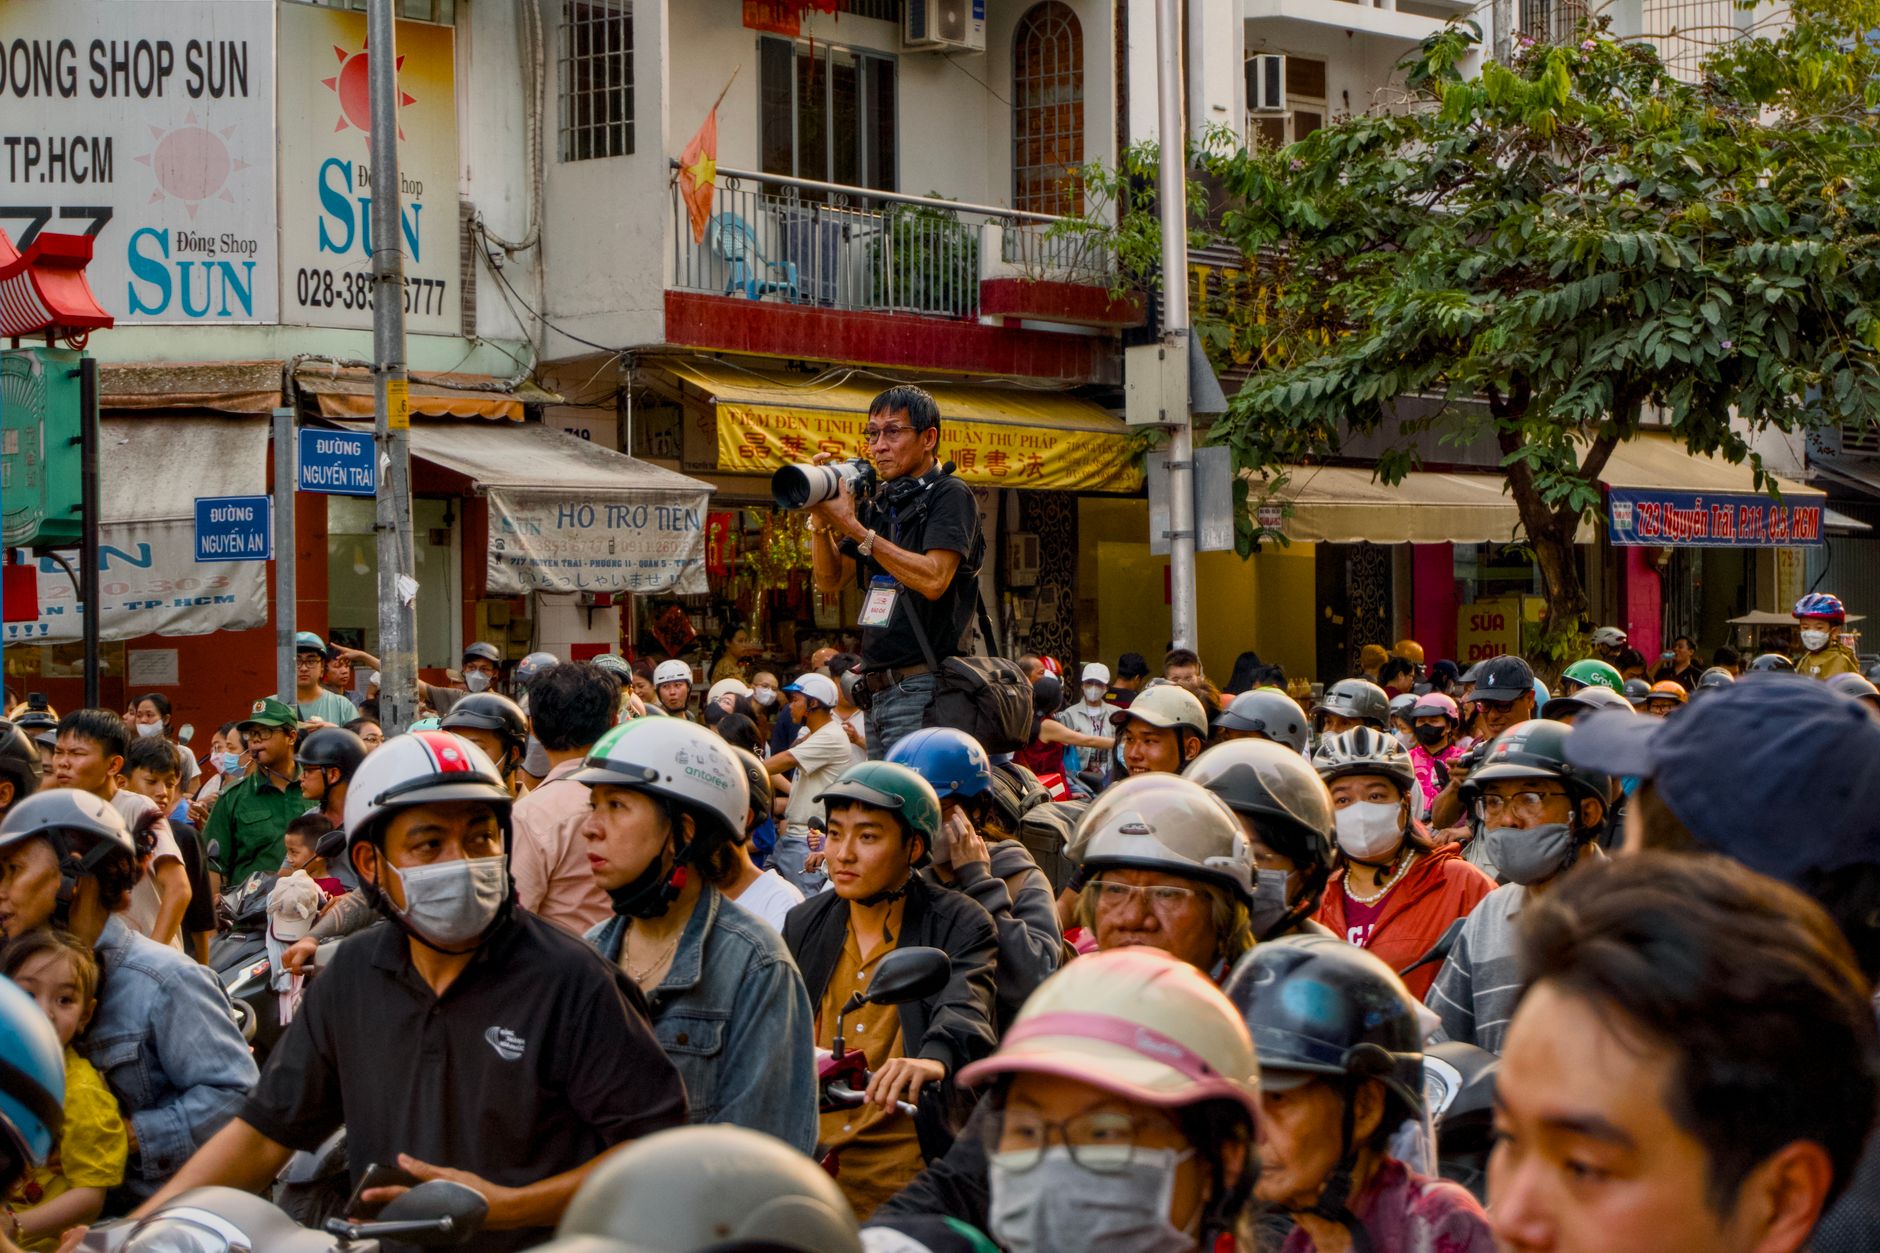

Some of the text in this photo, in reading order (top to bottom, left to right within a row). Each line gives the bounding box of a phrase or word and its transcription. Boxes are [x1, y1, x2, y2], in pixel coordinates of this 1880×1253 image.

[89, 39, 174, 98] SHOP
[186, 40, 249, 98] SUN
[4, 135, 113, 184] TP.HCM
[176, 230, 257, 259] Đông Shop
[775, 411, 808, 430] ĐÈN
[814, 418, 854, 434] TINH
[316, 437, 361, 456] ĐƯỜNG
[988, 432, 1018, 447] THƯ
[1020, 431, 1058, 450] PHÁP
[303, 460, 373, 487] NGUYỄN TRÃI
[210, 504, 253, 523] ĐƯỜNG
[557, 495, 596, 530] HỖ
[603, 504, 648, 536] TRỢ
[1637, 497, 1820, 543] 723 Nguyễn Trãi, P.11, Q.5, HCM
[201, 527, 264, 553] NGUYỄN ÁN
[123, 594, 236, 611] TP.HCM
[685, 766, 728, 790] antoree
